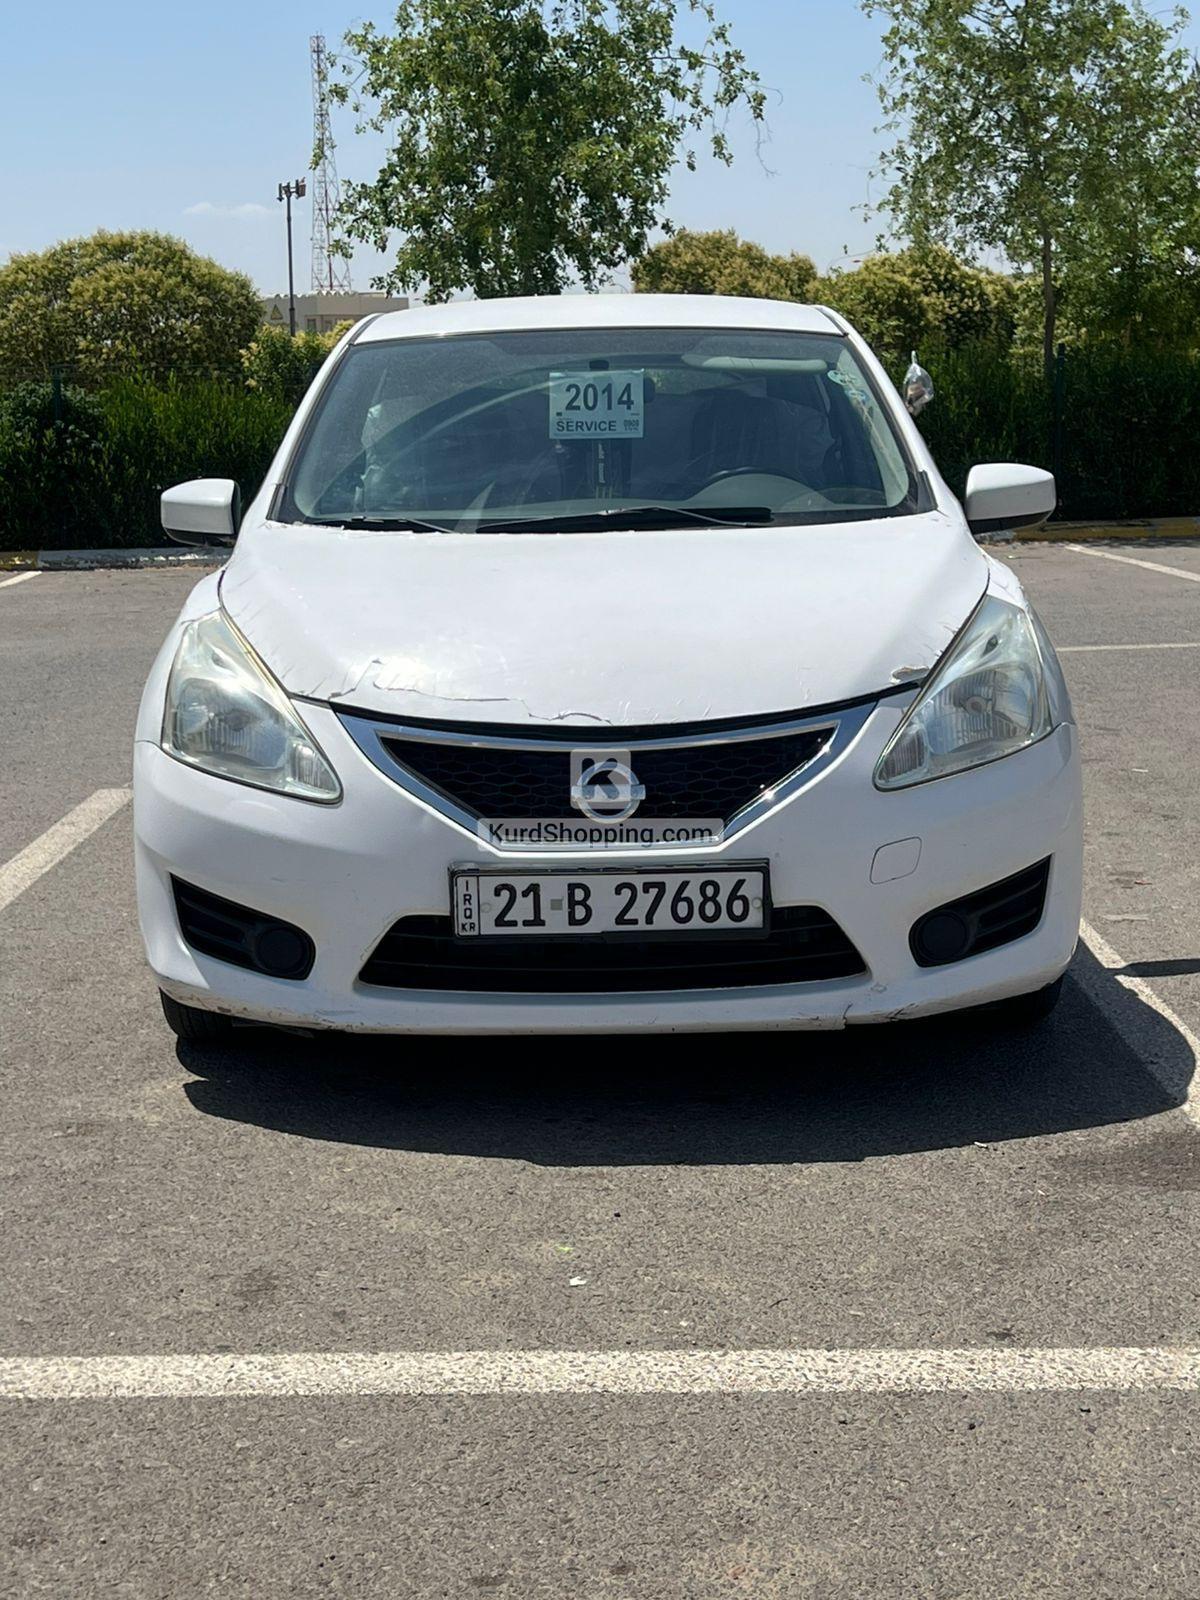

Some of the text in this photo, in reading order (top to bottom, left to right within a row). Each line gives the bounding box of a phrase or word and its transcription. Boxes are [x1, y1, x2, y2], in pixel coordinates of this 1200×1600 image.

[565, 382, 635, 411] 2014
[556, 420, 617, 432] SERVICE
[494, 878, 750, 927] 21 B 27686
